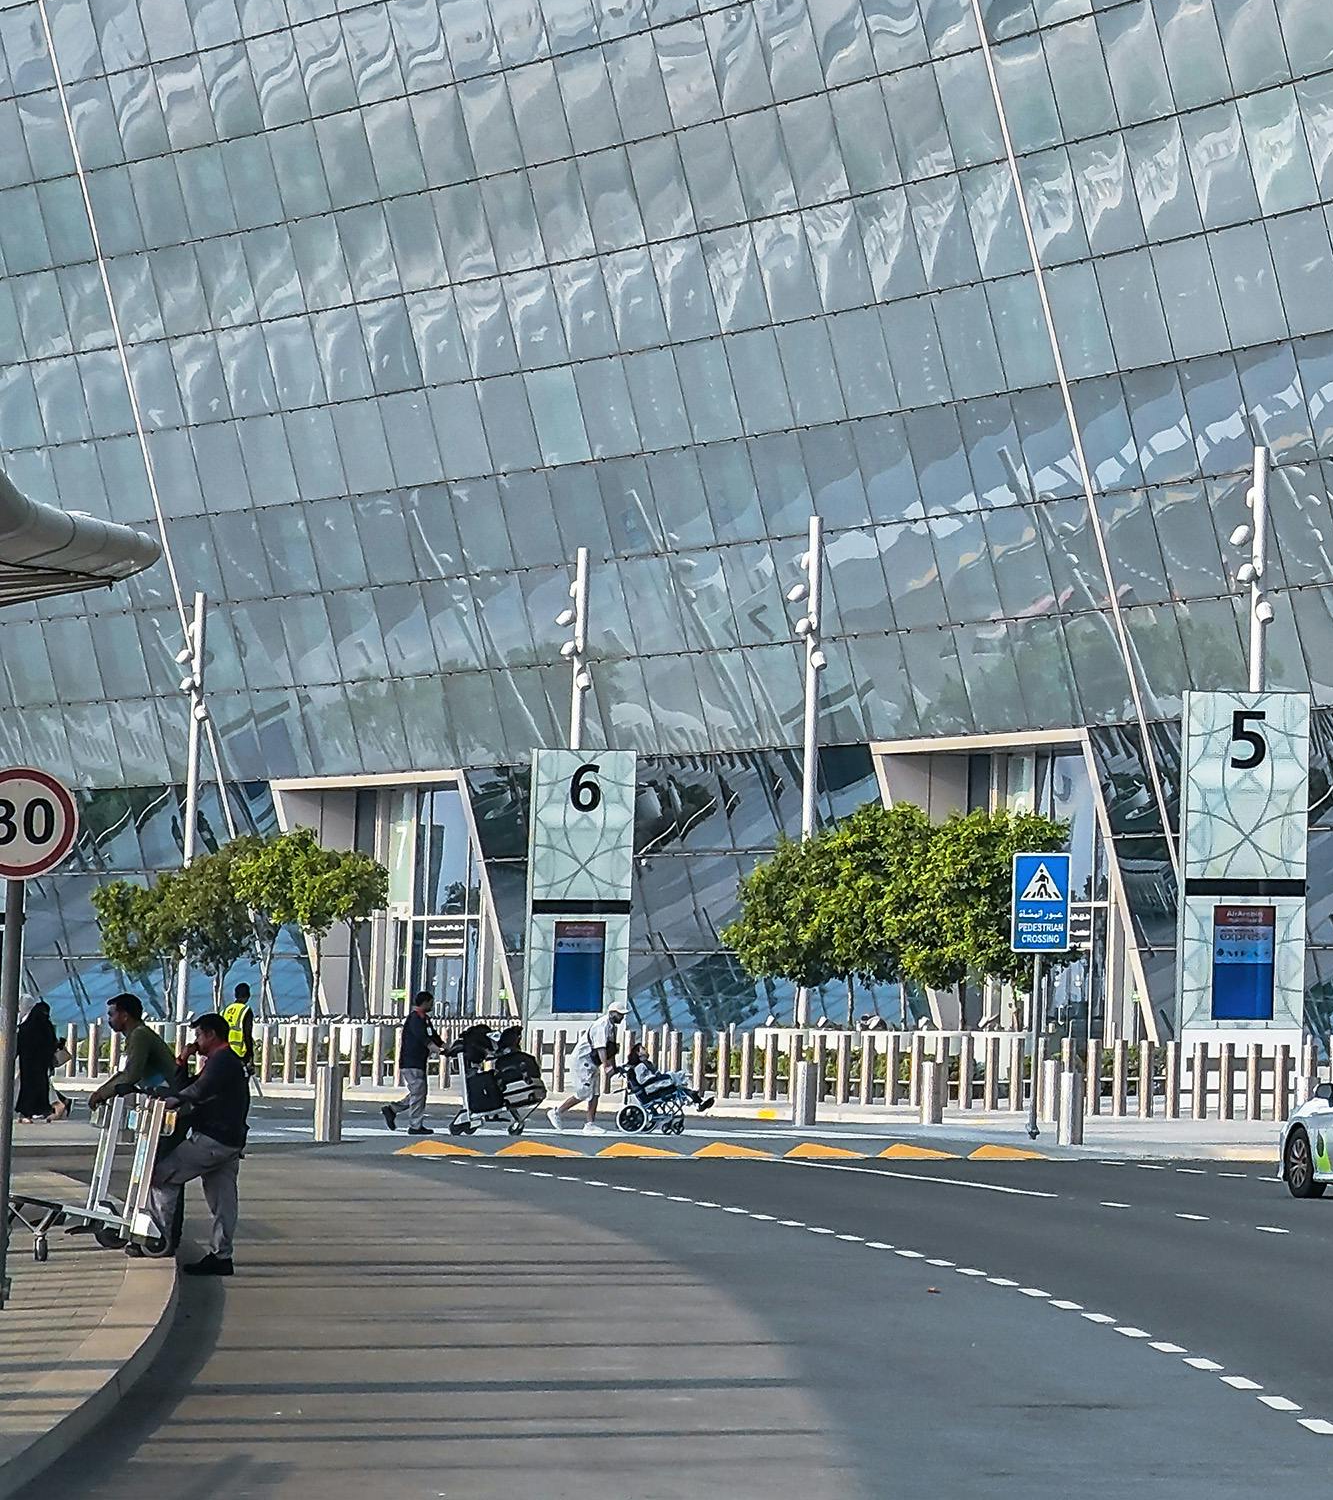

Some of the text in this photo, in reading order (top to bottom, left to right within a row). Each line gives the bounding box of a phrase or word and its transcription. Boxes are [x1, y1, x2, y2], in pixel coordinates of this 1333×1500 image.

[1231, 711, 1266, 769] 5
[571, 764, 600, 812] 6
[1044, 911, 1063, 920] عبور
[1018, 923, 1064, 932] PEDESTRIAN
[1021, 935, 1060, 943] CROSSING
